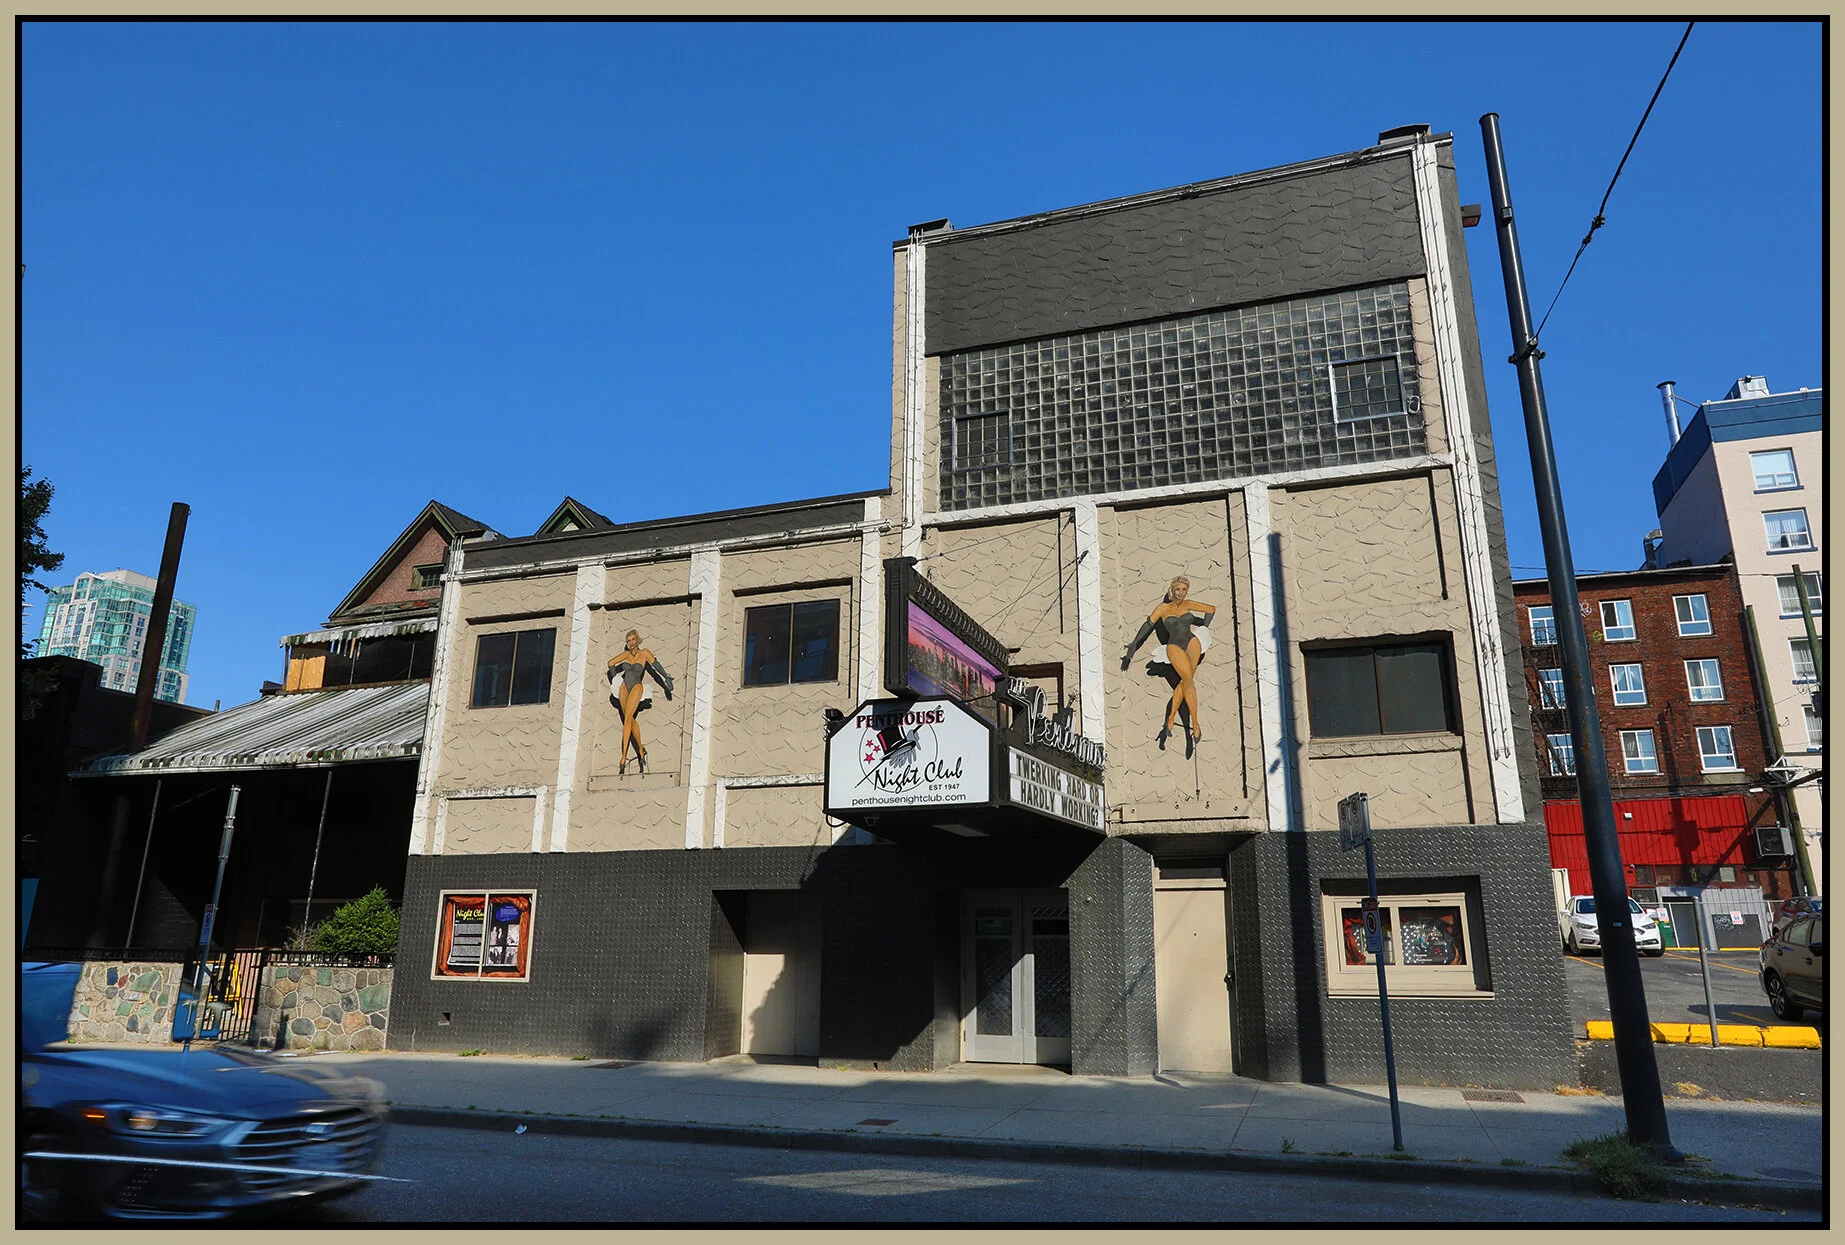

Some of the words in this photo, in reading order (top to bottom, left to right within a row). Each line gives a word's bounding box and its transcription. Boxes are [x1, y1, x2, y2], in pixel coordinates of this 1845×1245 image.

[874, 764, 921, 794] Night
[924, 756, 963, 783] Club
[1016, 754, 1061, 791] TWERKING
[1066, 775, 1086, 800] HARD
[1089, 786, 1100, 807] OR
[852, 793, 967, 806] penthousenightclub.com
[1021, 780, 1055, 812] HARDLY
[1061, 796, 1099, 827] WORKING?
[455, 908, 473, 921] Night
[473, 908, 485, 918] Clu
